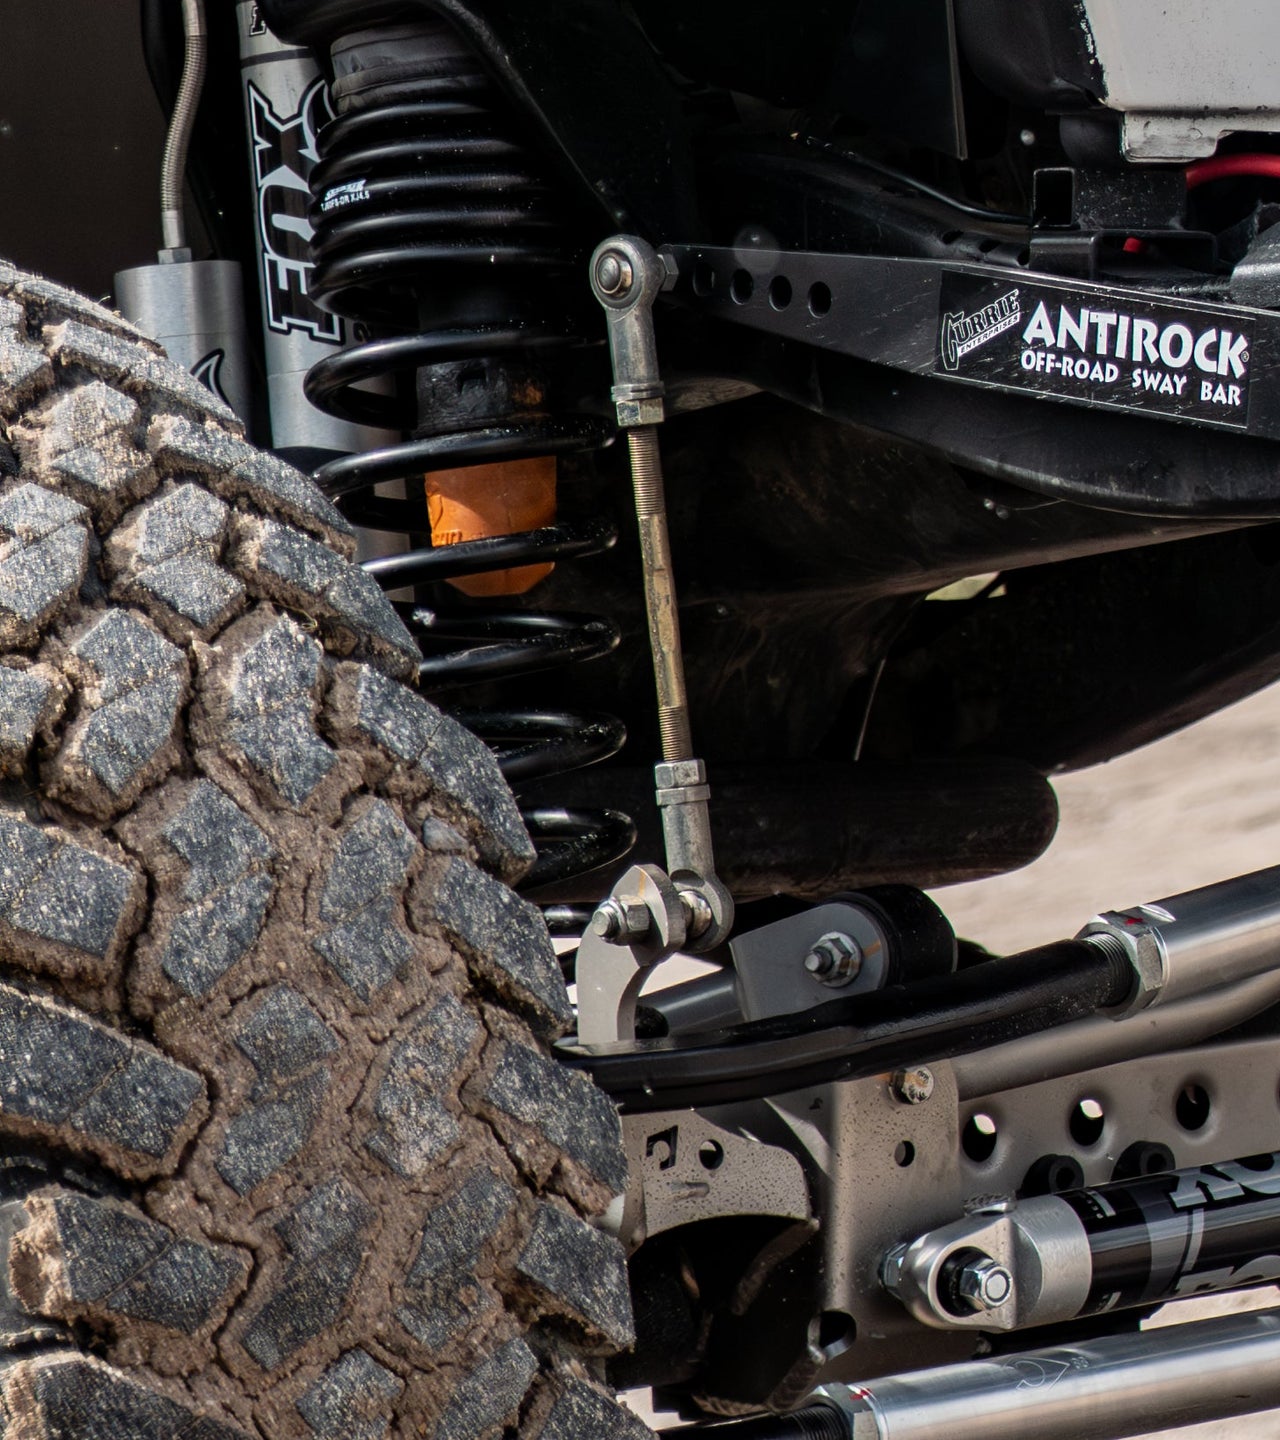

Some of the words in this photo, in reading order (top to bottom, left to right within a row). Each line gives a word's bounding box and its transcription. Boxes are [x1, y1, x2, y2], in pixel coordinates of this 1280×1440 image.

[941, 288, 1020, 371] CURRIE
[1020, 349, 1119, 383] OFF-ROAD
[1131, 368, 1187, 396] SWAY
[1200, 381, 1242, 406] BAR
